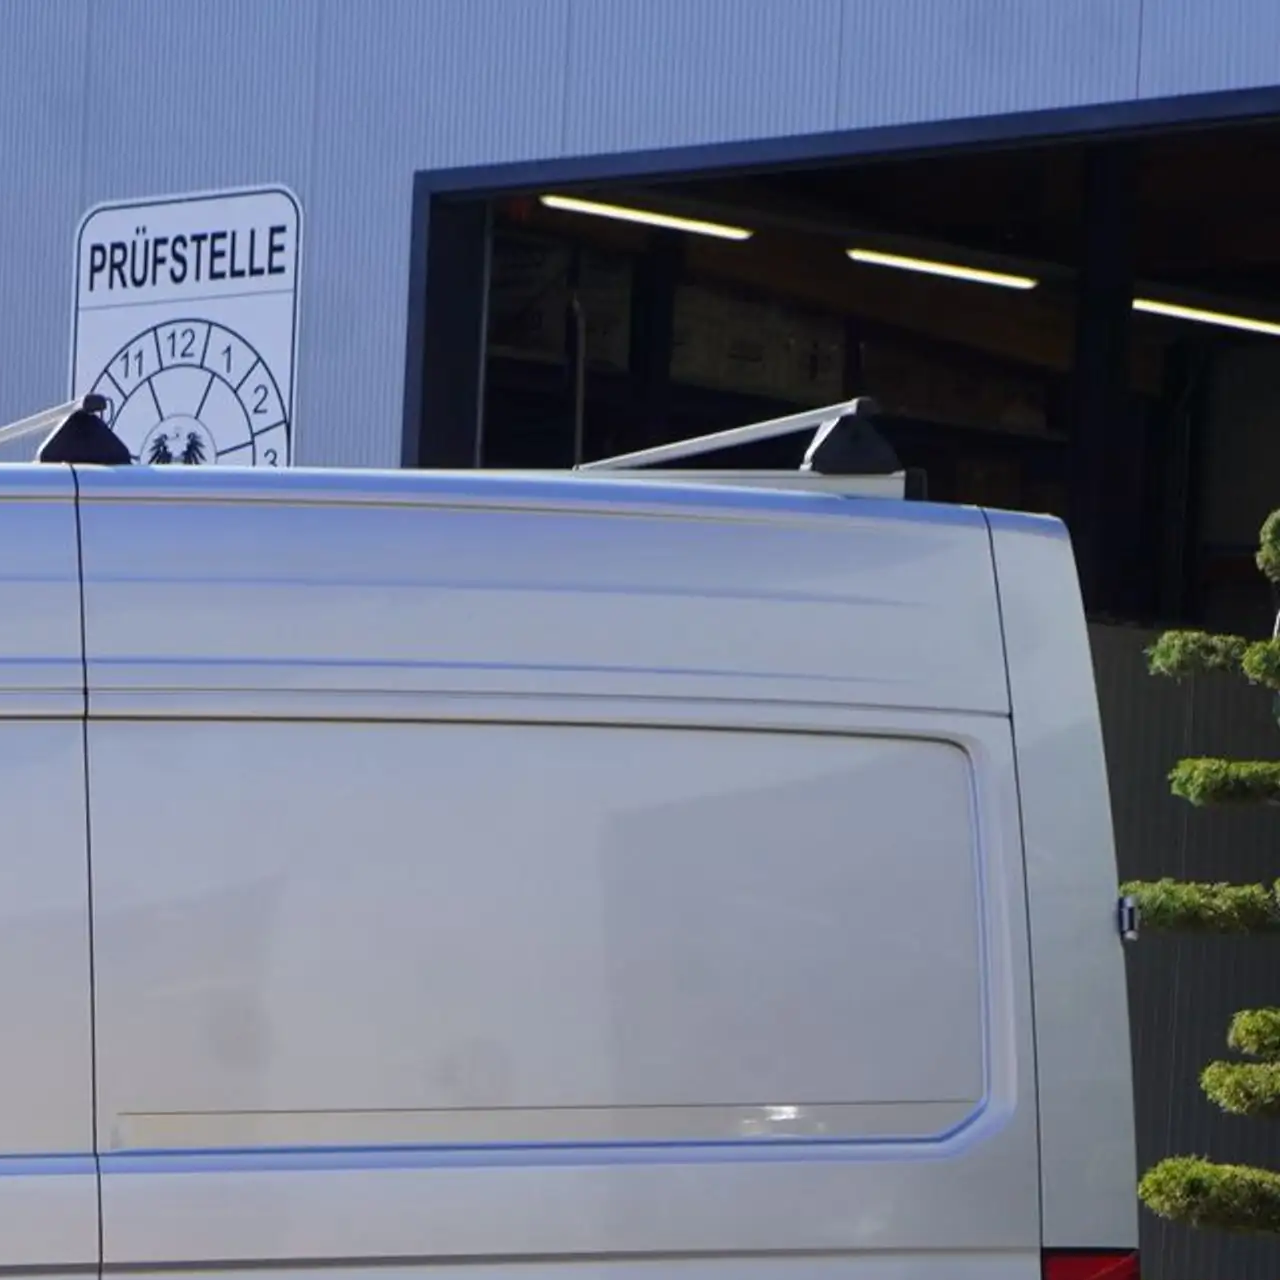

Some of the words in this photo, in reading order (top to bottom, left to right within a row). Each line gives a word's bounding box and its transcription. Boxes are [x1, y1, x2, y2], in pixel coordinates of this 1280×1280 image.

[89, 225, 287, 292] PRÜFSTELLE
[166, 328, 196, 359] 12
[119, 349, 144, 379] 11
[220, 345, 233, 374] 1
[252, 383, 270, 414] 2
